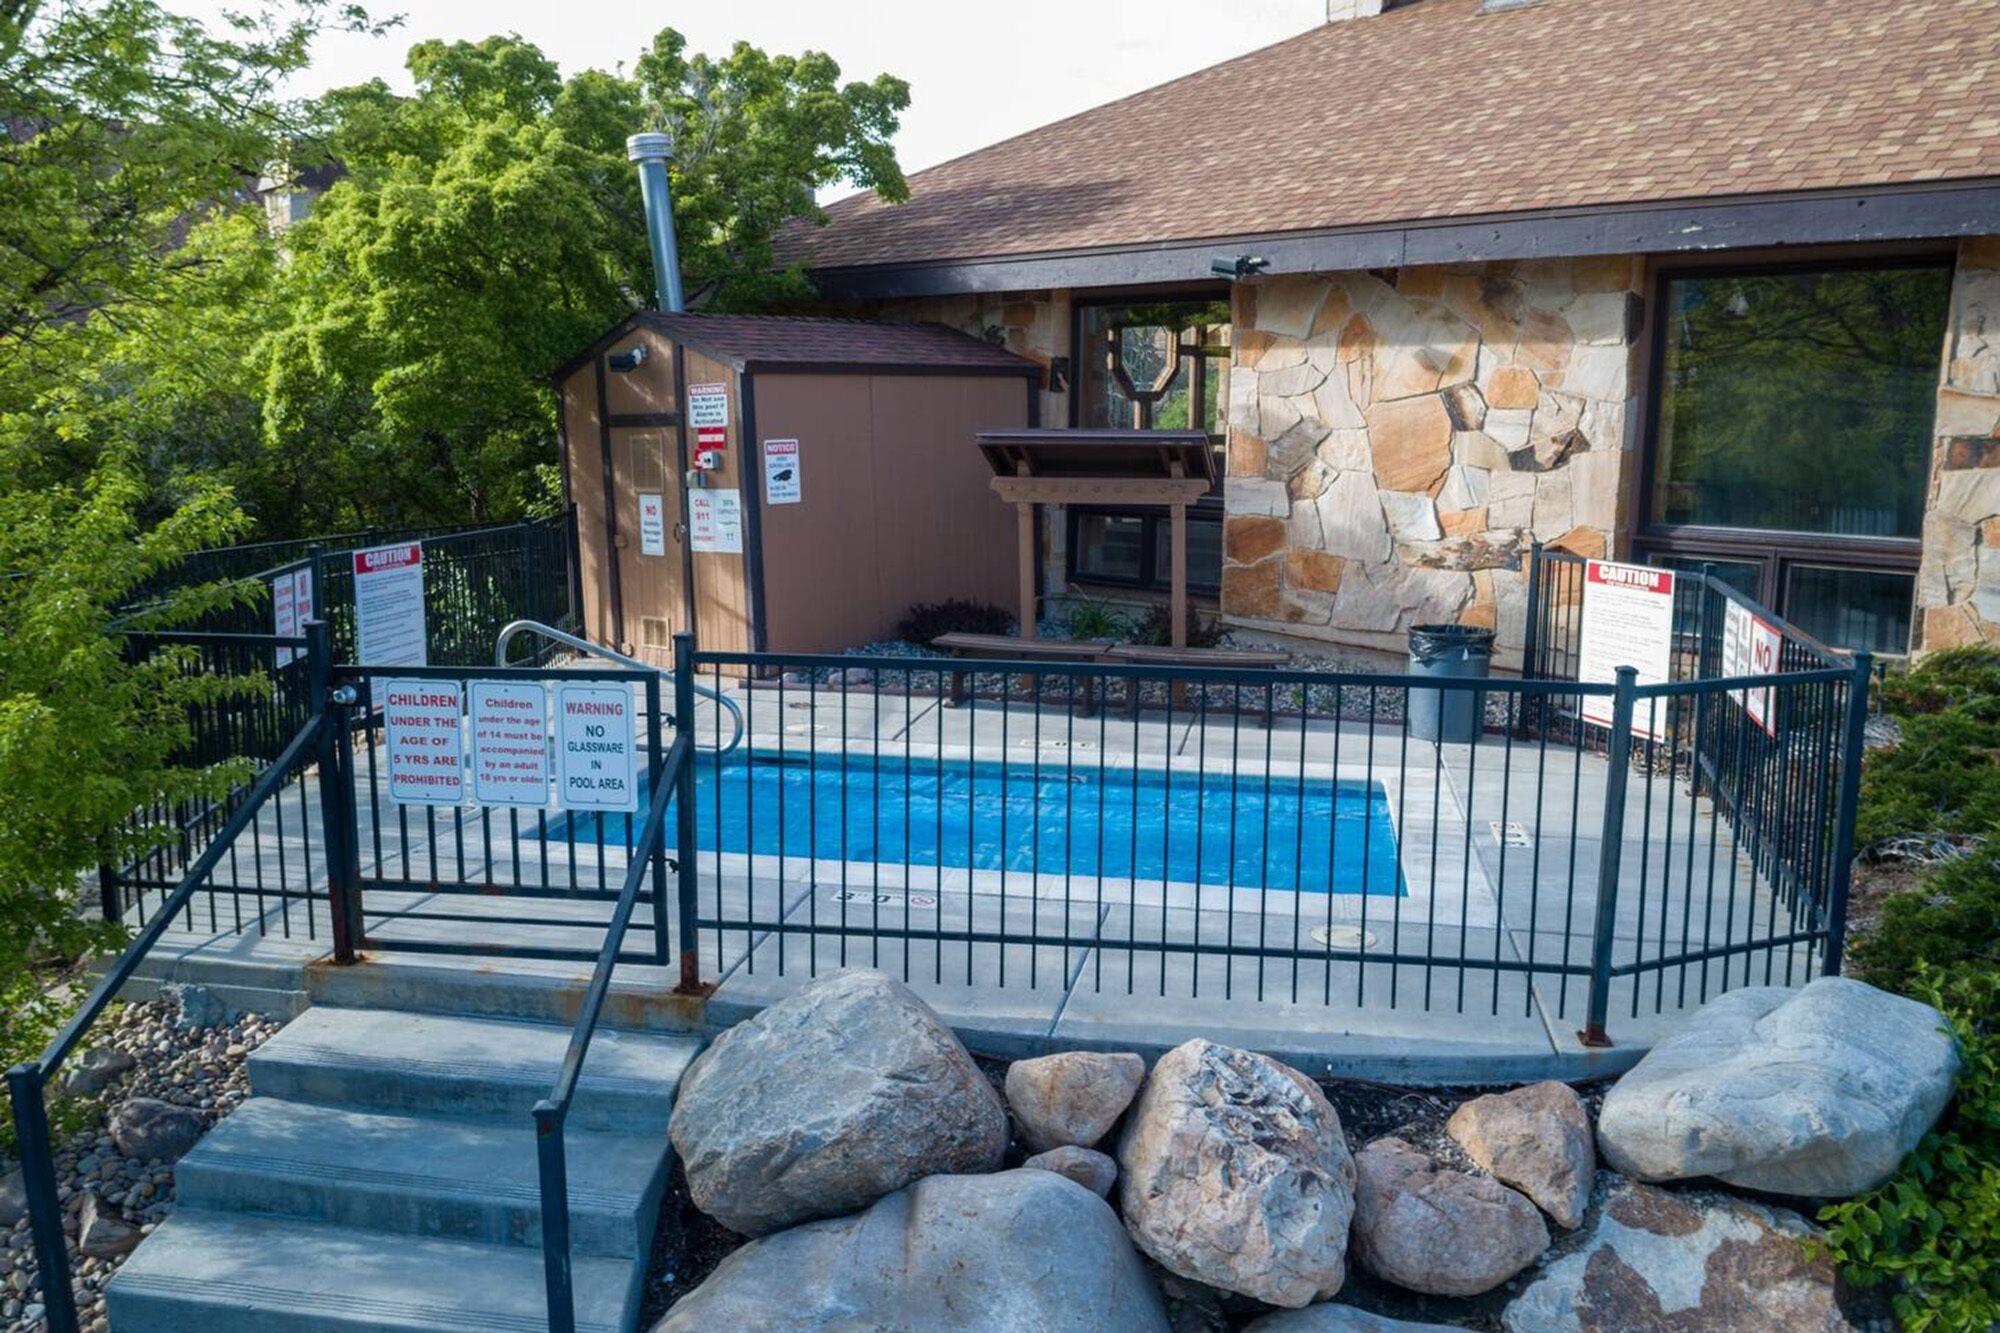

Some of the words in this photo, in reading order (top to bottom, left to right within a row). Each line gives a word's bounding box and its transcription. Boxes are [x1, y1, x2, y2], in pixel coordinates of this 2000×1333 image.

[767, 444, 795, 453] NOTICE
[695, 498, 710, 508] CALL
[365, 547, 412, 568] CAUTION
[1599, 565, 1660, 588] CAUTION
[1754, 637, 1771, 673] NO
[388, 693, 457, 707] CHILDREN
[485, 698, 533, 709] Children
[566, 702, 624, 716] WARNING
[390, 716, 431, 727] UNDER
[433, 717, 458, 728] THE
[506, 716, 521, 724] the
[524, 718, 540, 726] age
[503, 732, 528, 740] must
[585, 725, 605, 738] NO
[400, 736, 427, 745] AGE
[432, 737, 450, 746] OF
[480, 746, 545, 756] accompanied
[567, 741, 624, 754] GLASSWARE
[393, 754, 401, 764] 5
[405, 755, 430, 765] YRS
[433, 756, 458, 766] ARE
[485, 760, 496, 769] by
[499, 761, 511, 769] an
[514, 761, 538, 770] adult
[591, 760, 602, 770] IN
[393, 774, 460, 786] PROHIBITED
[480, 773, 491, 781] 18
[493, 775, 507, 783] yrs
[520, 776, 543, 784] older
[569, 776, 596, 789] POOL
[598, 778, 625, 790] AREA
